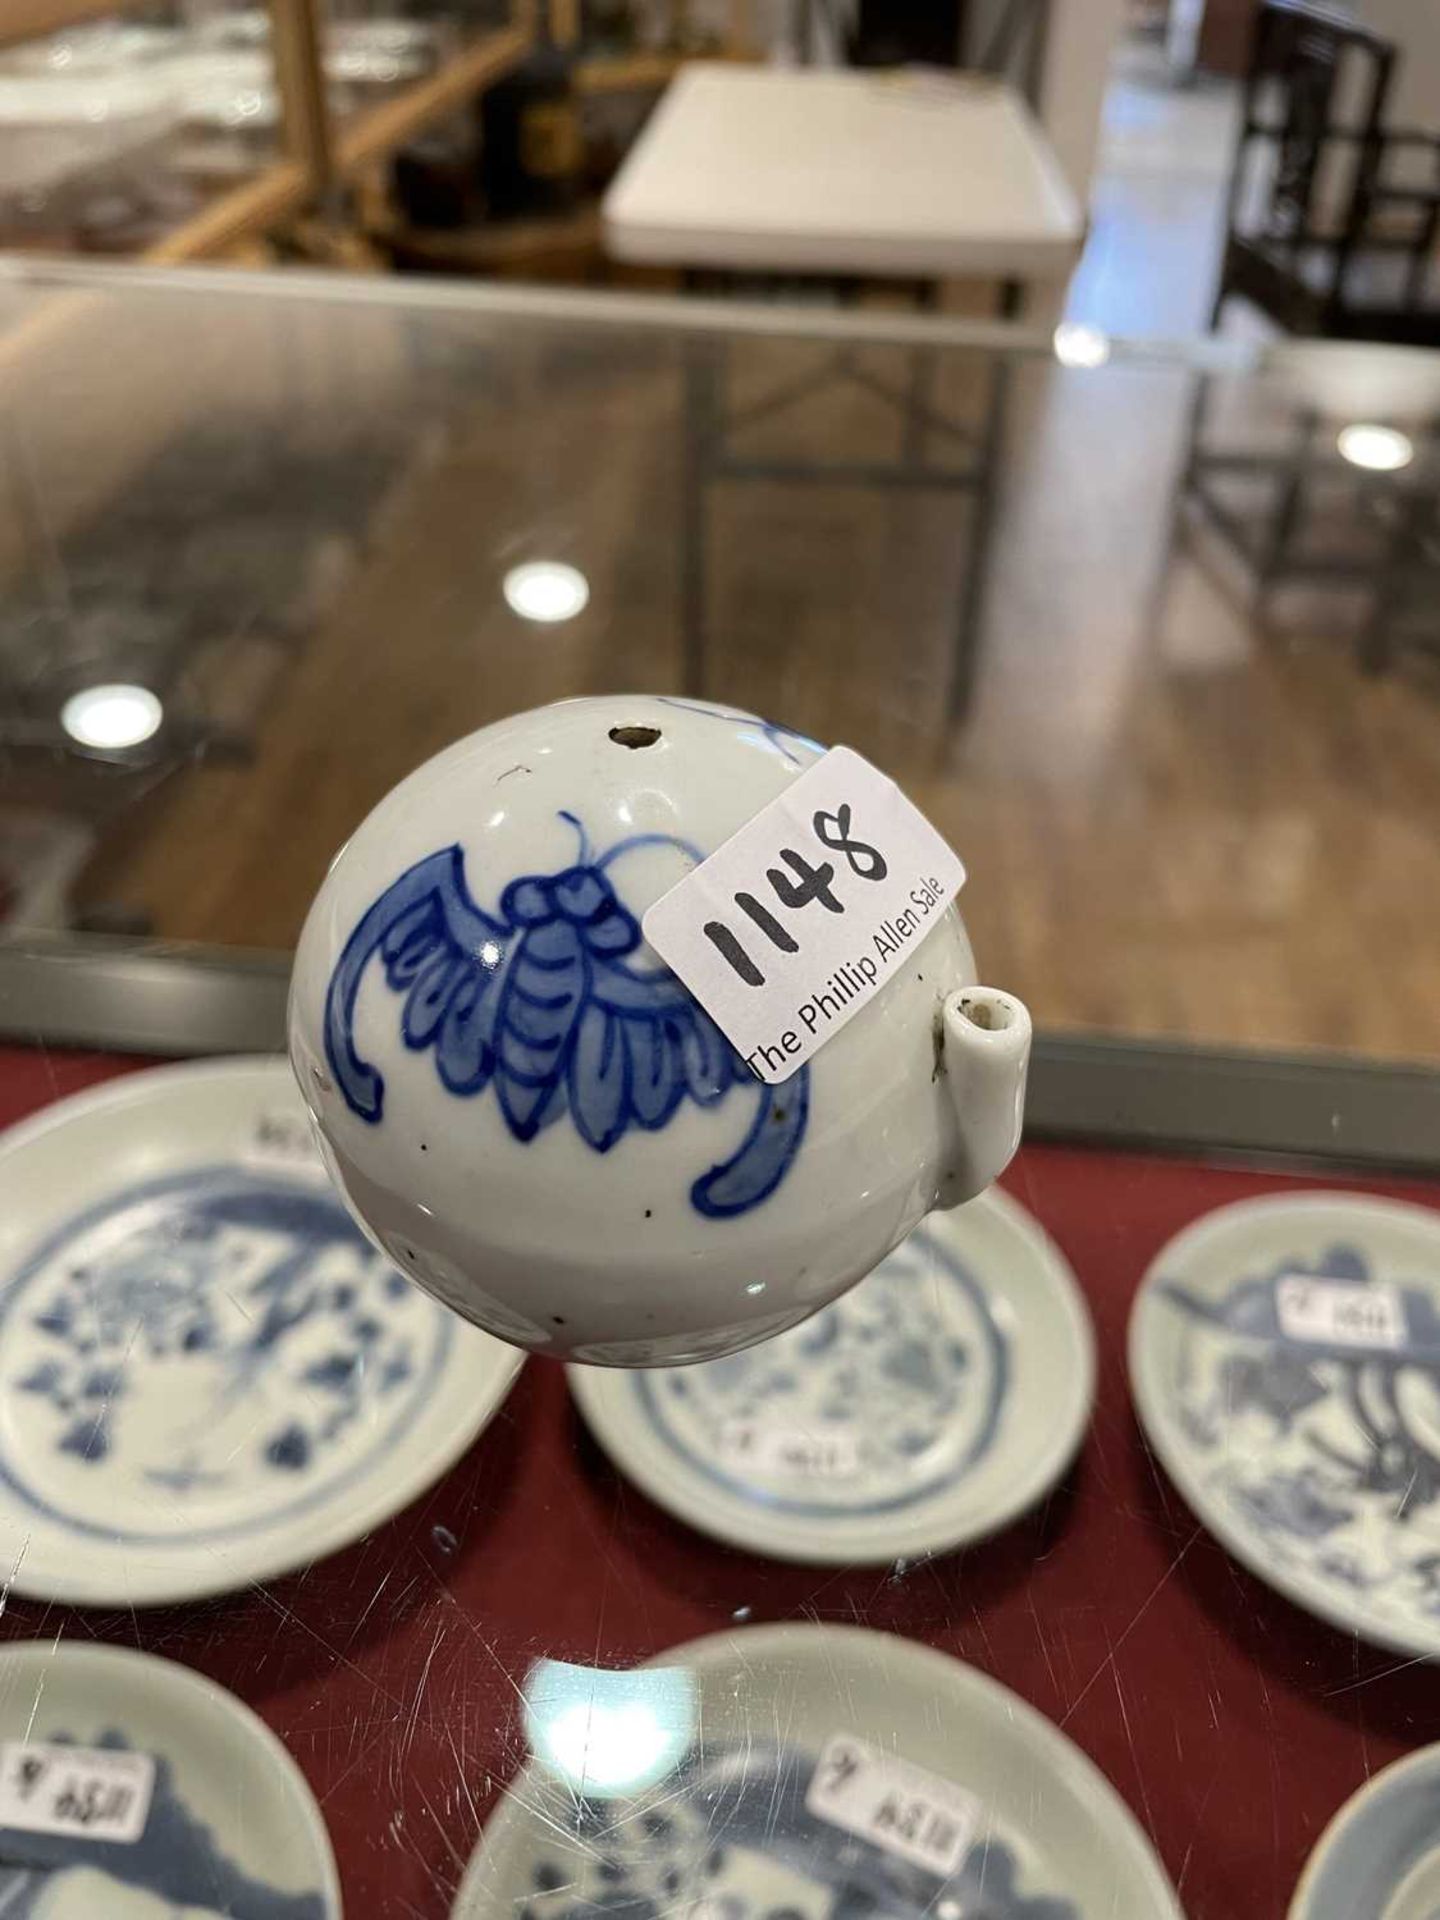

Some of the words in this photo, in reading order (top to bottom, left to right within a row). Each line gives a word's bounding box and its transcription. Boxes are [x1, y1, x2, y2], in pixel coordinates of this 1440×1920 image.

[703, 803, 888, 987] 1148
[744, 1030, 802, 1081] The
[797, 956, 878, 1034] Phillip
[871, 912, 922, 963] Allen
[909, 876, 945, 915] Sale
